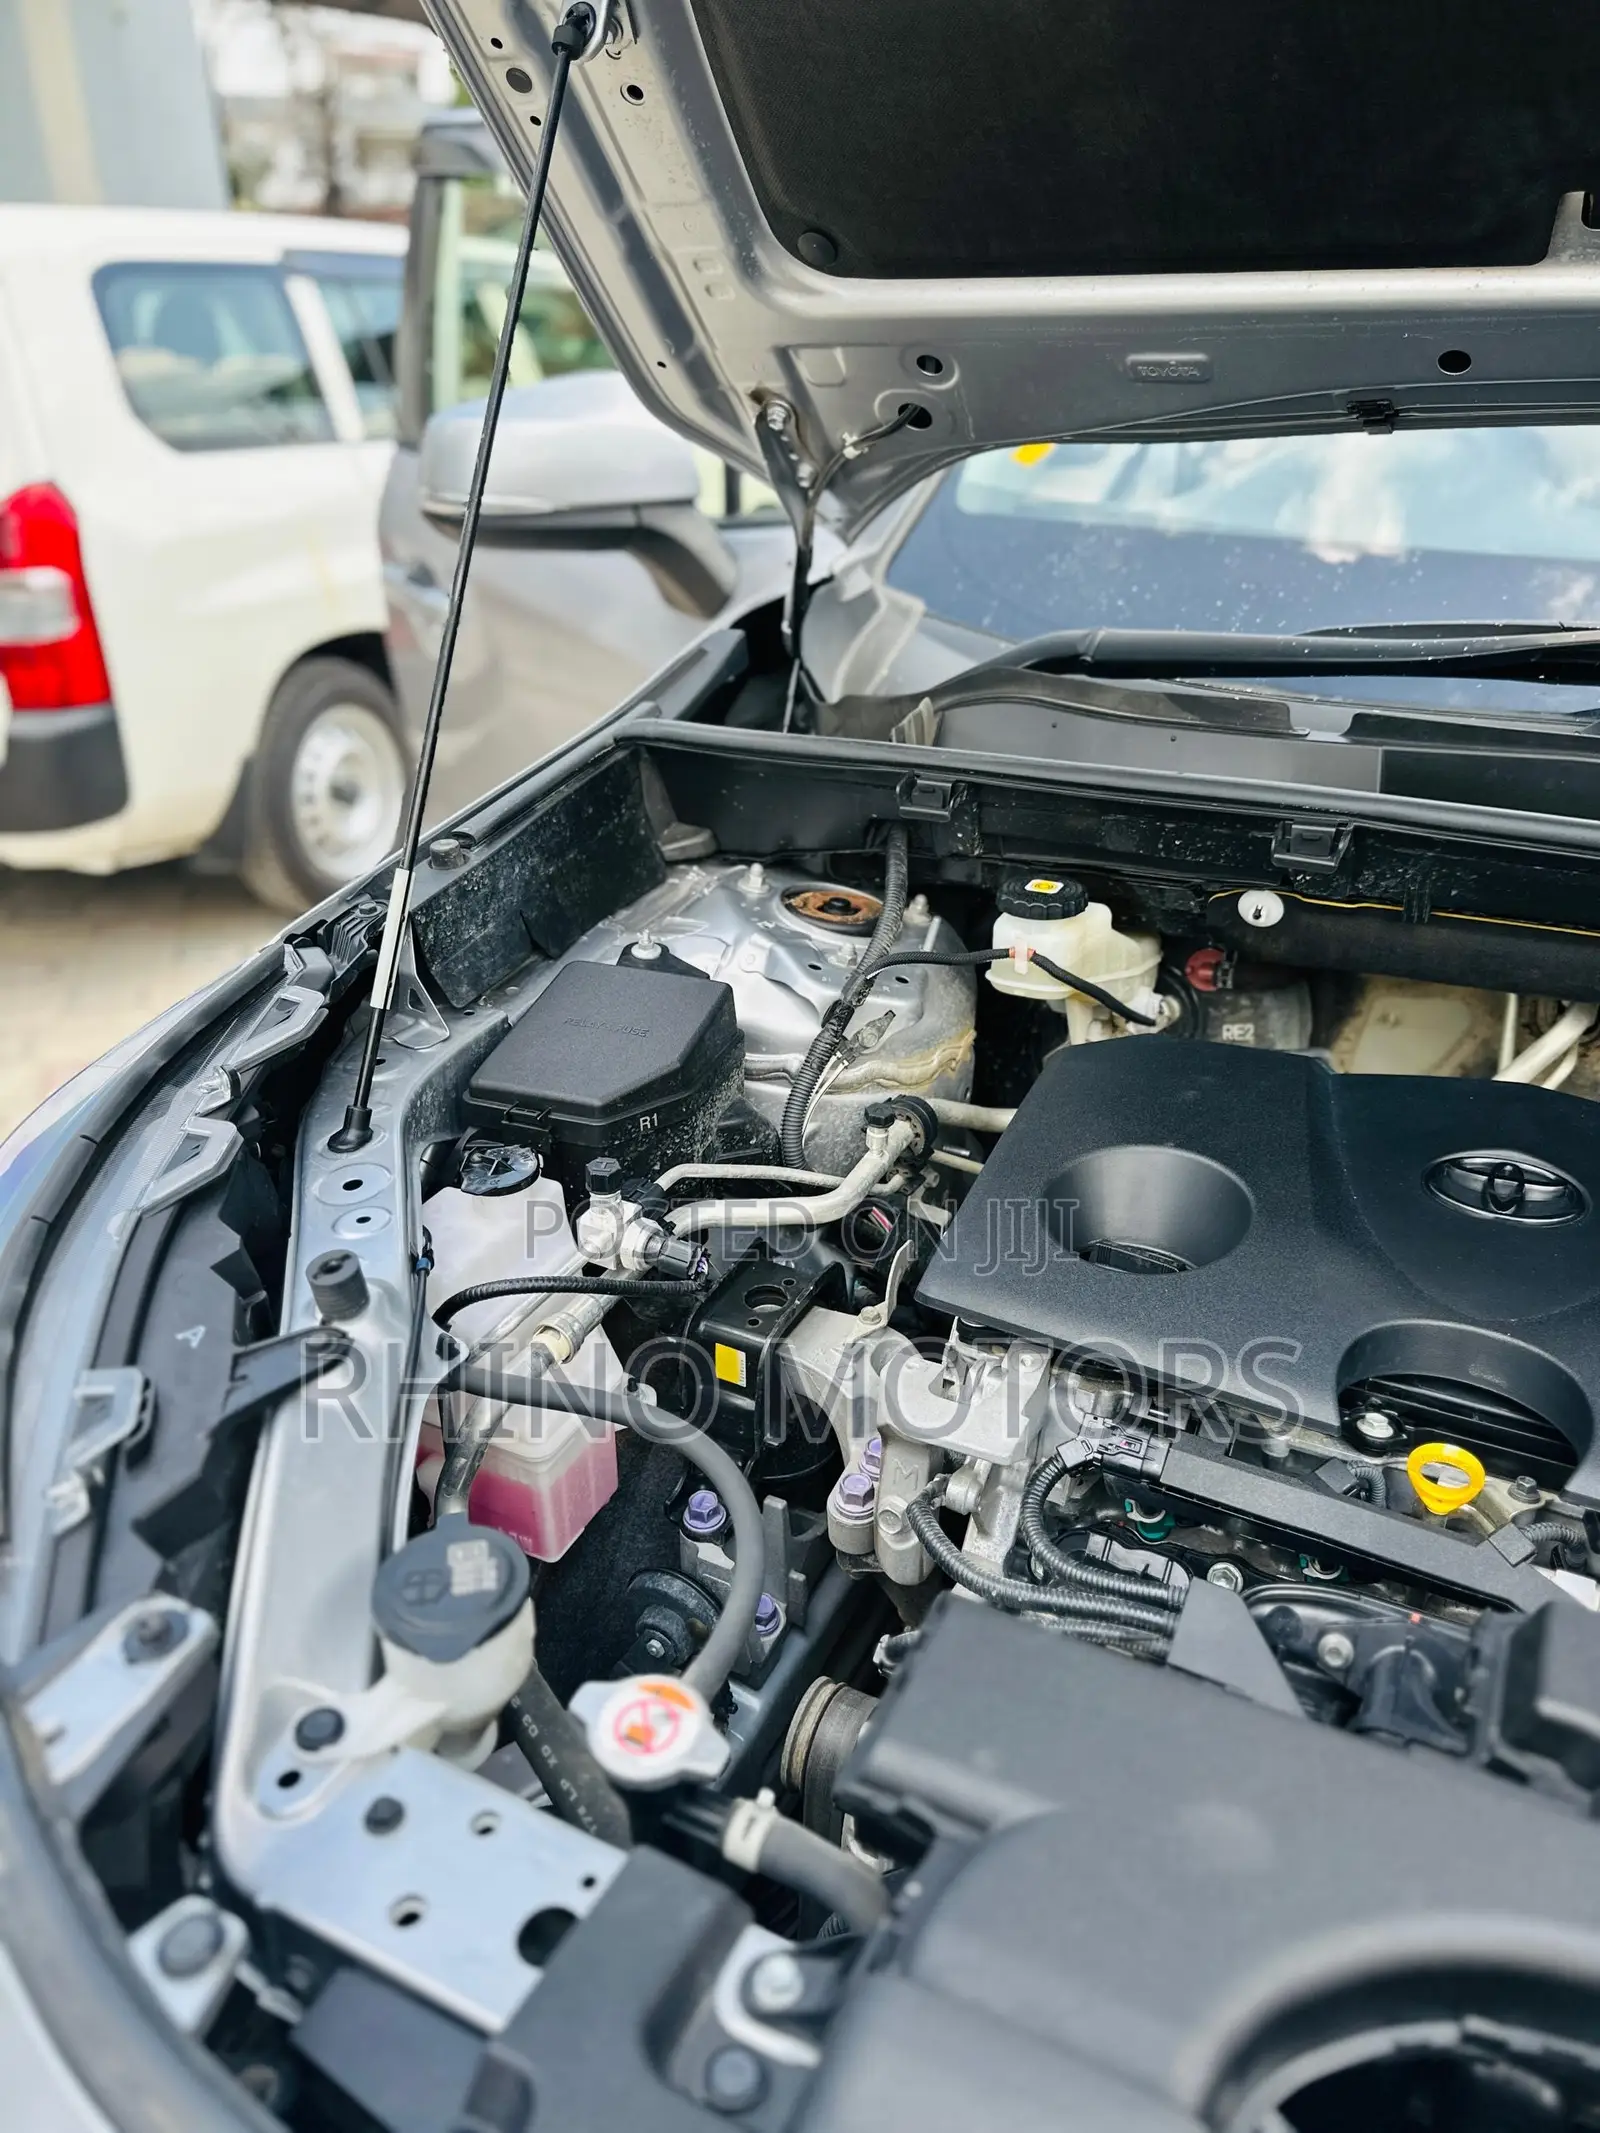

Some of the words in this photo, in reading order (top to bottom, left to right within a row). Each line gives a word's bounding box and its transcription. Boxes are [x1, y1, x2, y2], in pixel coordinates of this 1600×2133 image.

[1137, 366, 1200, 377] TOYOTA
[640, 1112, 658, 1131] R1
[174, 1325, 206, 1349] A
